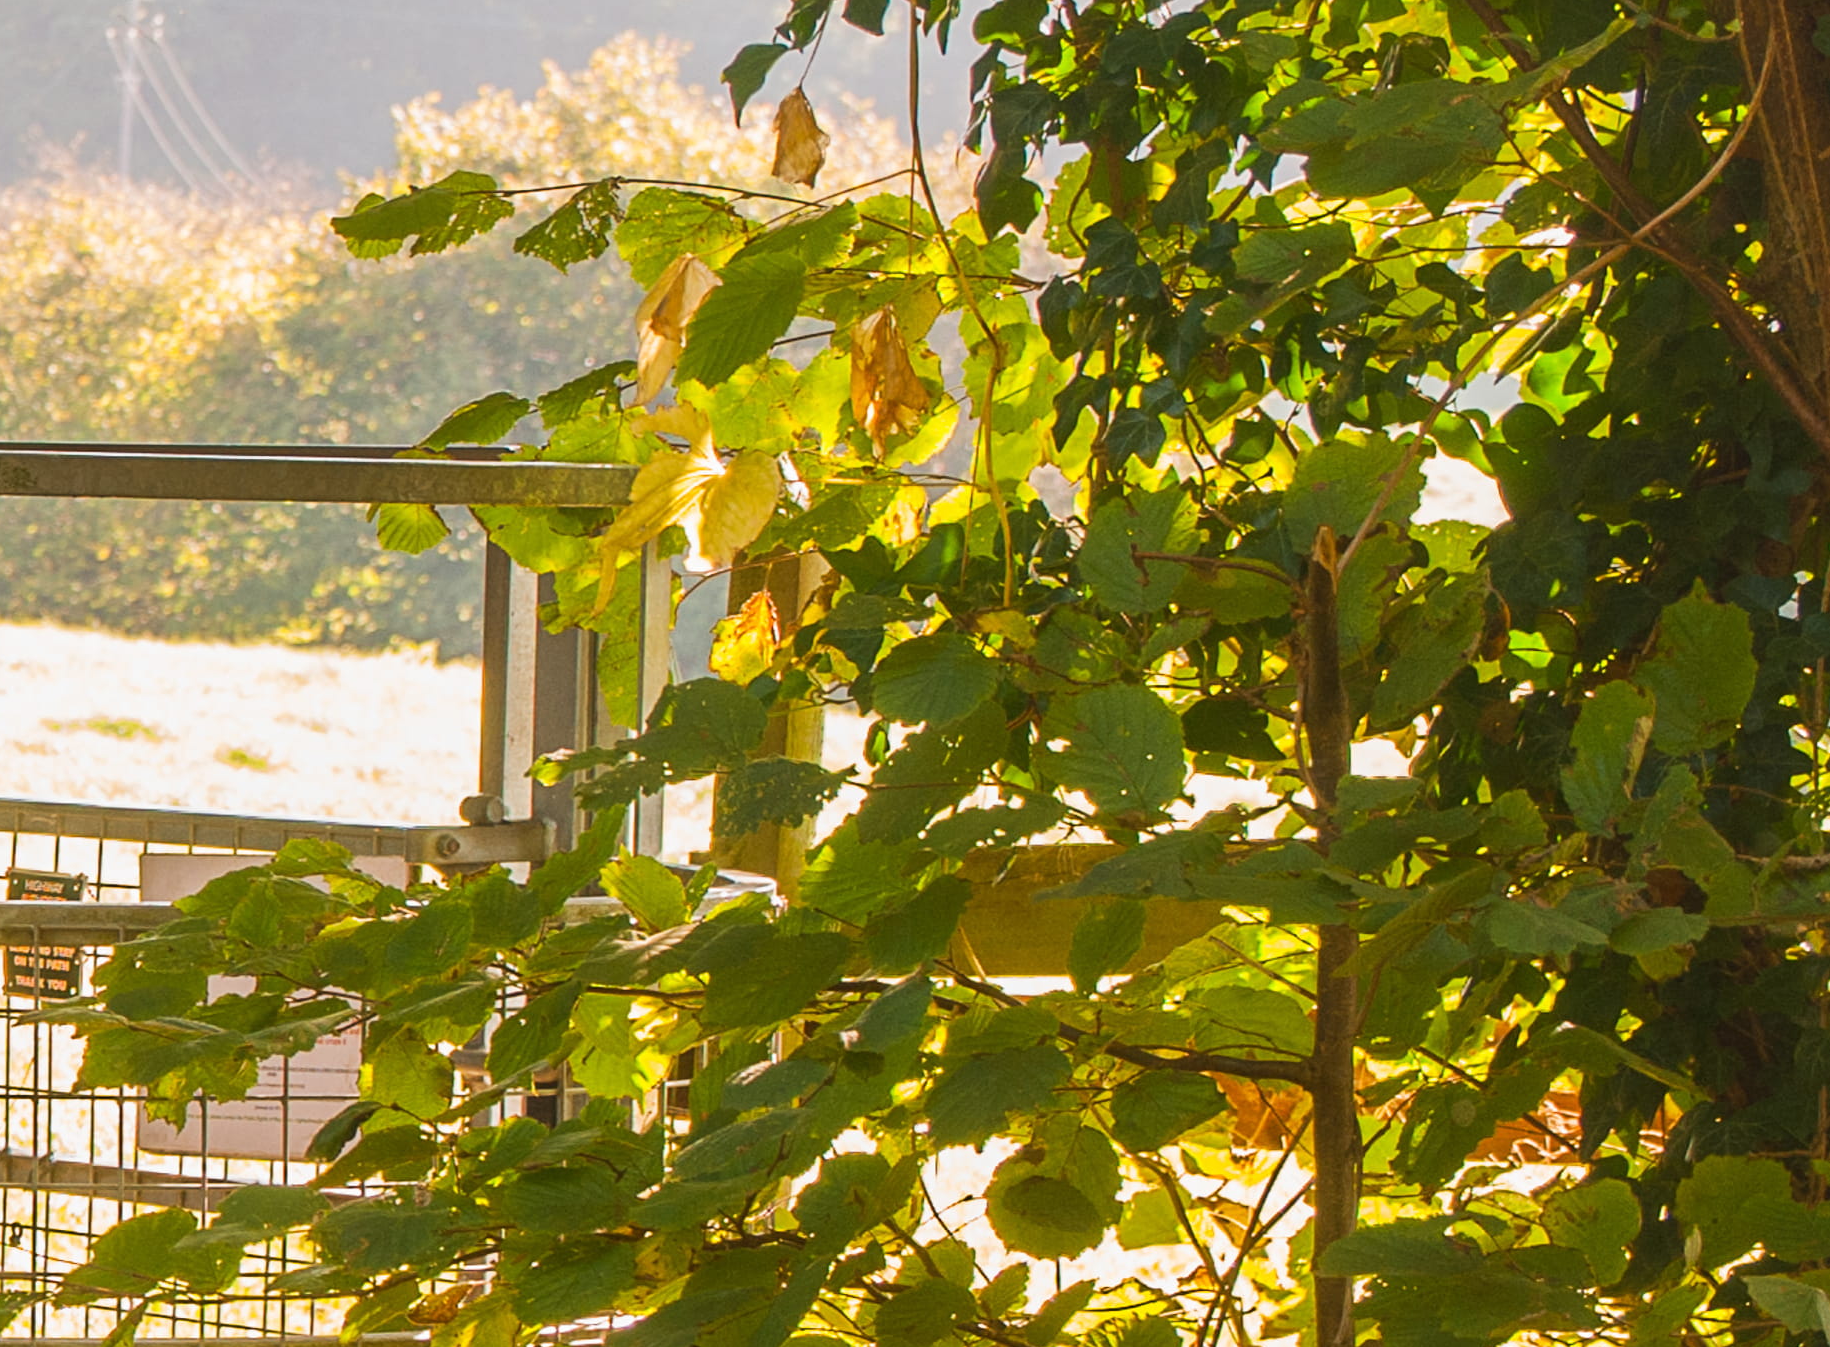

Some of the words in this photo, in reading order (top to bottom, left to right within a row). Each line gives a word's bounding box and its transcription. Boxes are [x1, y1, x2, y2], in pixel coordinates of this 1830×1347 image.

[29, 956, 45, 969] TE
[15, 974, 45, 988] THAK
[47, 978, 67, 991] YOU
